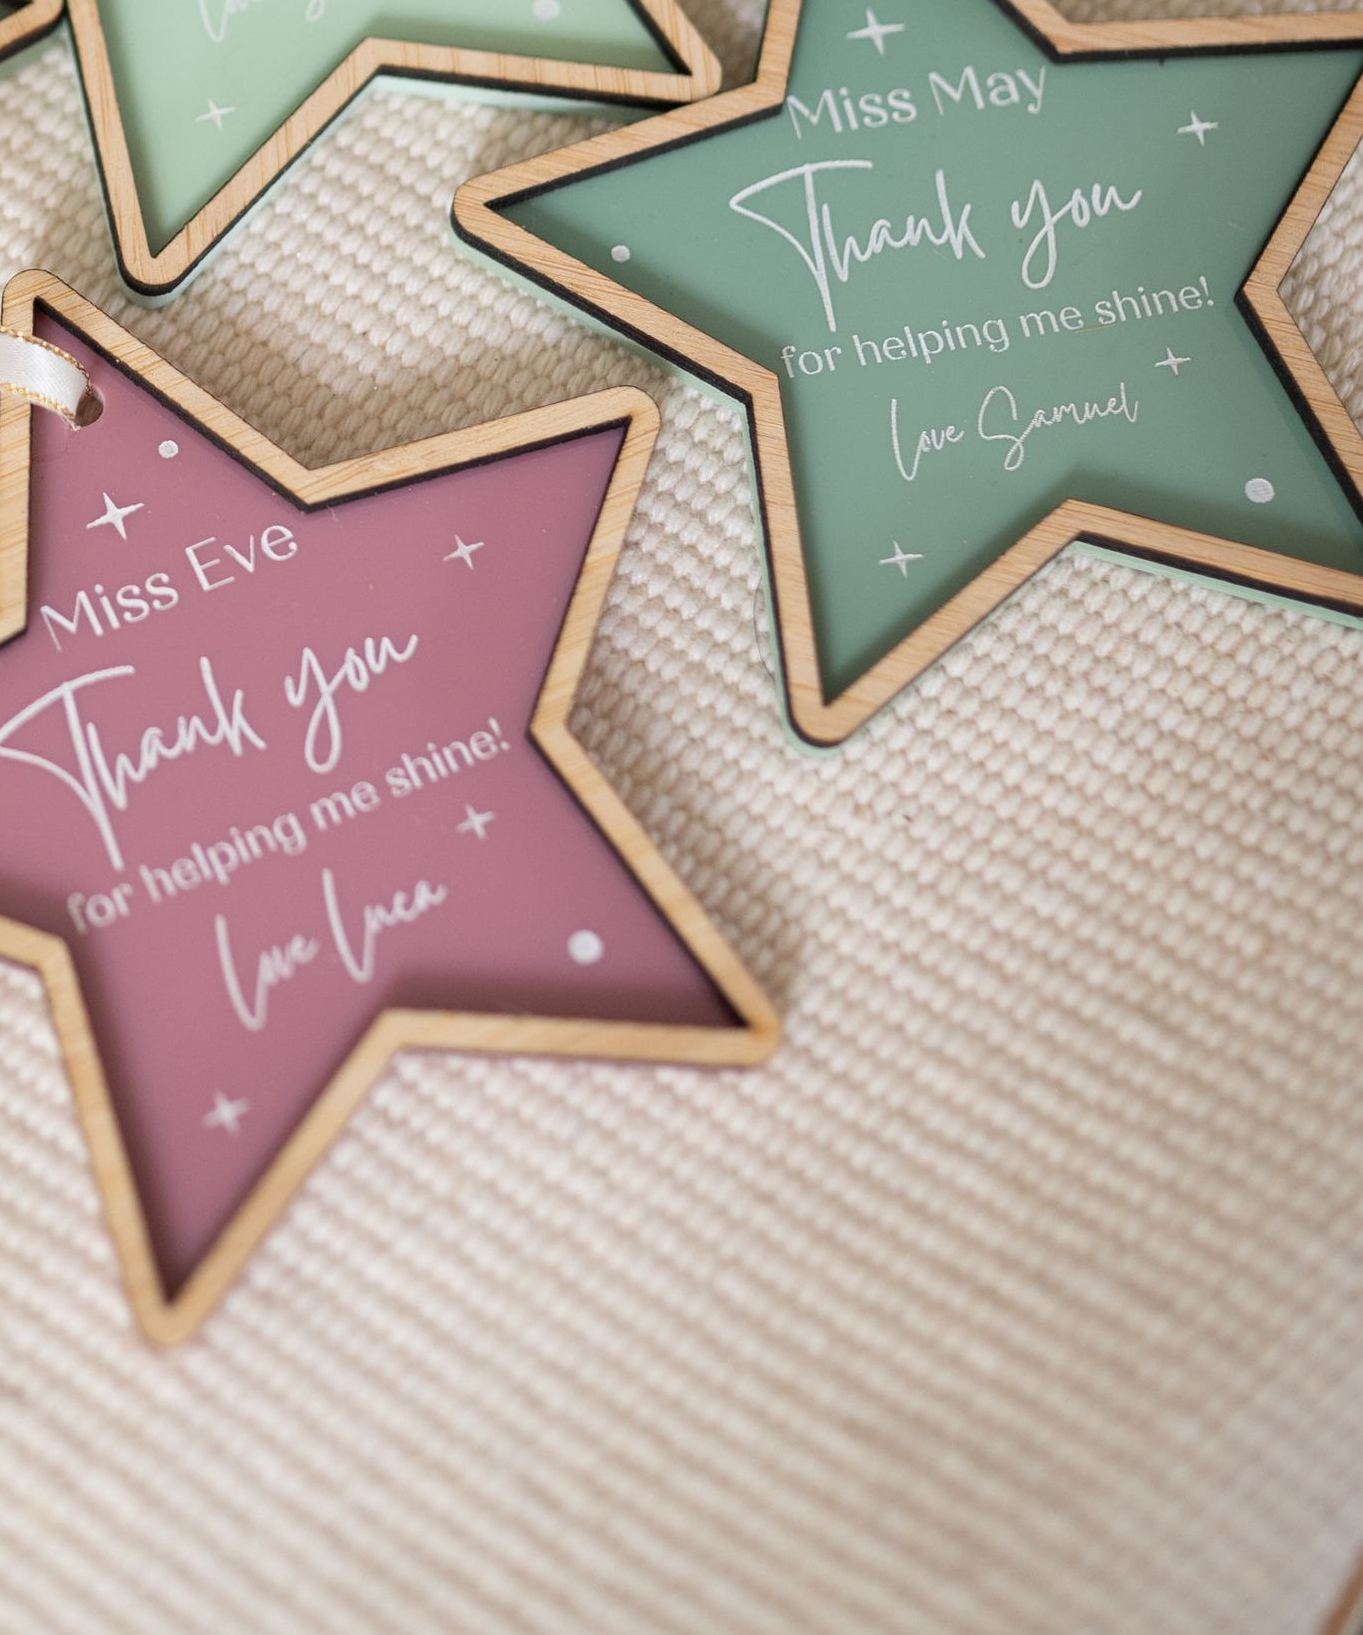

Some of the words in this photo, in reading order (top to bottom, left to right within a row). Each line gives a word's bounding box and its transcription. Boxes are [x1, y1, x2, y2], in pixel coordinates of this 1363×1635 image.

[786, 87, 917, 140] Miss
[928, 65, 1047, 115] May
[729, 159, 986, 332] Thank
[1011, 179, 1142, 288] you
[781, 345, 842, 379] for
[853, 318, 1009, 367] helping
[1020, 306, 1084, 338] me
[1095, 276, 1214, 324] shine!
[890, 398, 964, 481] Love
[978, 382, 1139, 470] Samuel
[40, 571, 178, 652] Miss
[185, 523, 297, 591] Eve
[285, 634, 418, 773] you
[67, 882, 134, 934] for
[139, 812, 306, 903] helping
[310, 781, 380, 832] me
[385, 717, 511, 798] shine!
[216, 914, 319, 1031] Love
[323, 868, 447, 983] Luca
